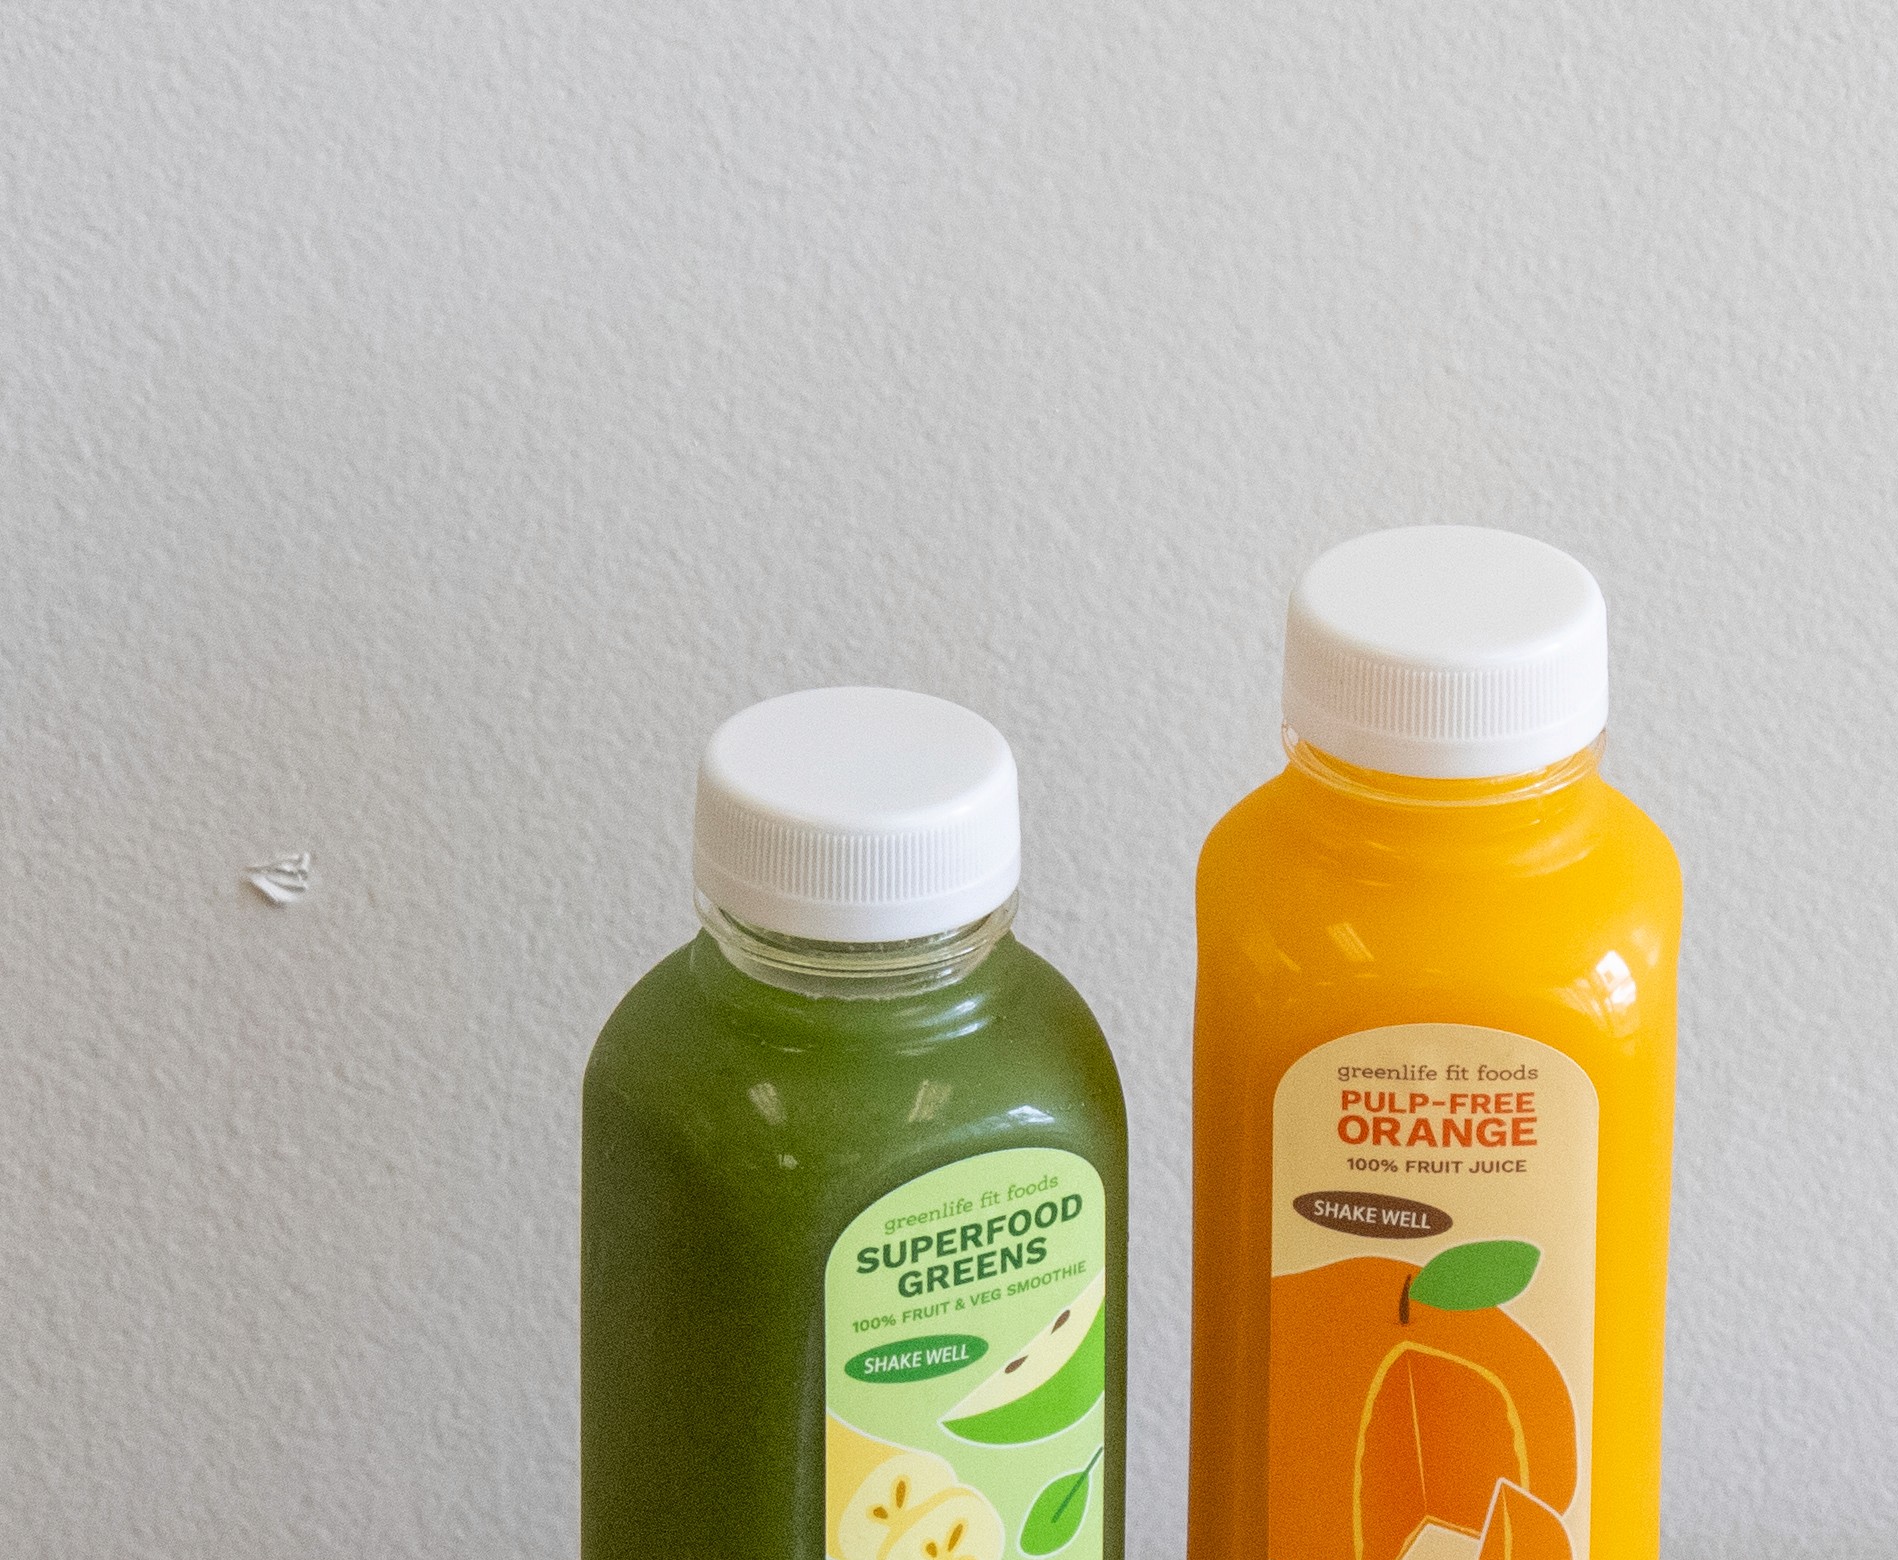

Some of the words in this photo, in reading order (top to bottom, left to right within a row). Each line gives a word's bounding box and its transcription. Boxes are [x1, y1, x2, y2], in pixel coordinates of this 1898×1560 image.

[1338, 1064, 1437, 1081] greenlife
[1446, 1064, 1469, 1081] fit
[1477, 1065, 1538, 1081] foods
[1341, 1089, 1536, 1114] PULP-FREE
[1337, 1115, 1538, 1148] ORANGE
[1347, 1158, 1398, 1173] 100%
[1406, 1160, 1463, 1174] FRUIT
[1468, 1159, 1527, 1174] JUICE
[885, 1198, 973, 1235] greenlife
[980, 1191, 1000, 1209] fit
[1007, 1175, 1058, 1200] foods
[1314, 1200, 1377, 1223] SHAKE
[1382, 1208, 1431, 1229] WELL
[856, 1193, 1083, 1274] SUPERFOOD
[898, 1237, 1047, 1298] GREENS
[852, 1314, 896, 1333] 100%
[902, 1302, 950, 1324] FRUIT
[955, 1298, 966, 1310] &
[969, 1289, 1002, 1307] VEG
[1007, 1261, 1087, 1296] SMOOTHIE
[864, 1351, 921, 1375] SHAKE
[926, 1344, 969, 1365] WELL
